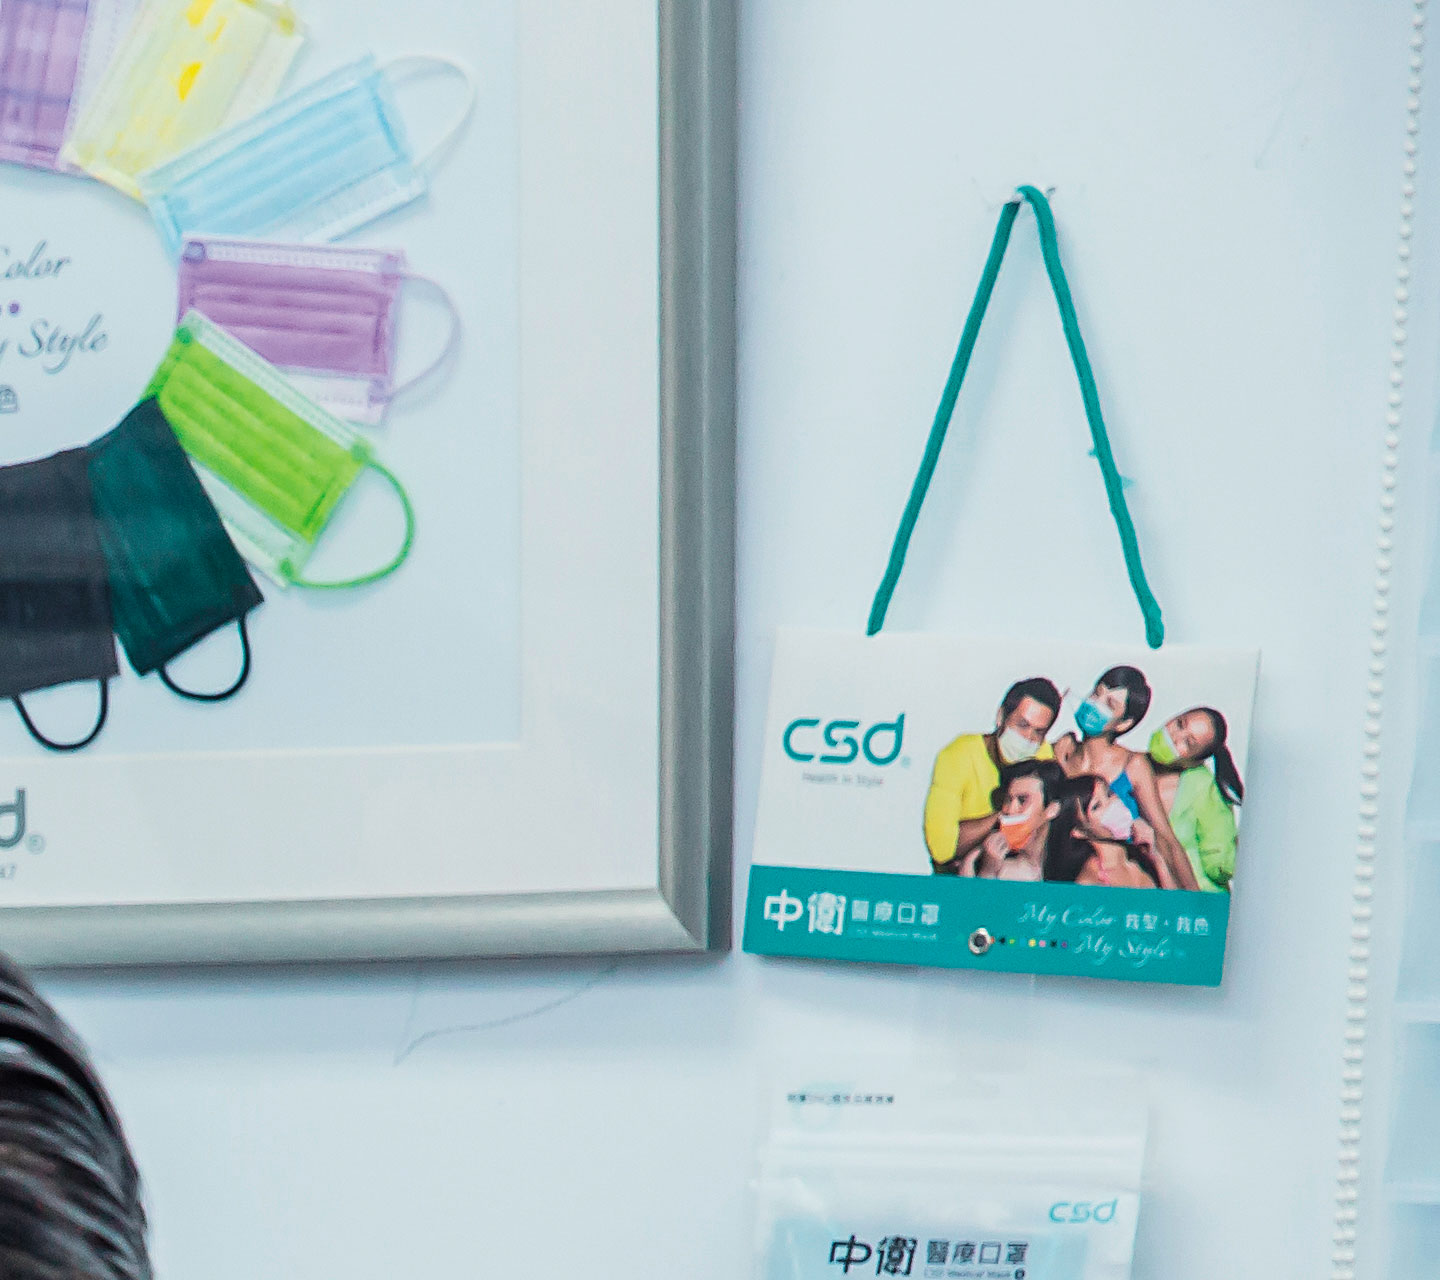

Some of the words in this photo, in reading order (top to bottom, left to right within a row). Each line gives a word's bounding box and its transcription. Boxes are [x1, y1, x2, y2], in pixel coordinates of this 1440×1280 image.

[18, 313, 108, 375] Style
[783, 712, 905, 766] csd
[1048, 1198, 1118, 1224] csd
